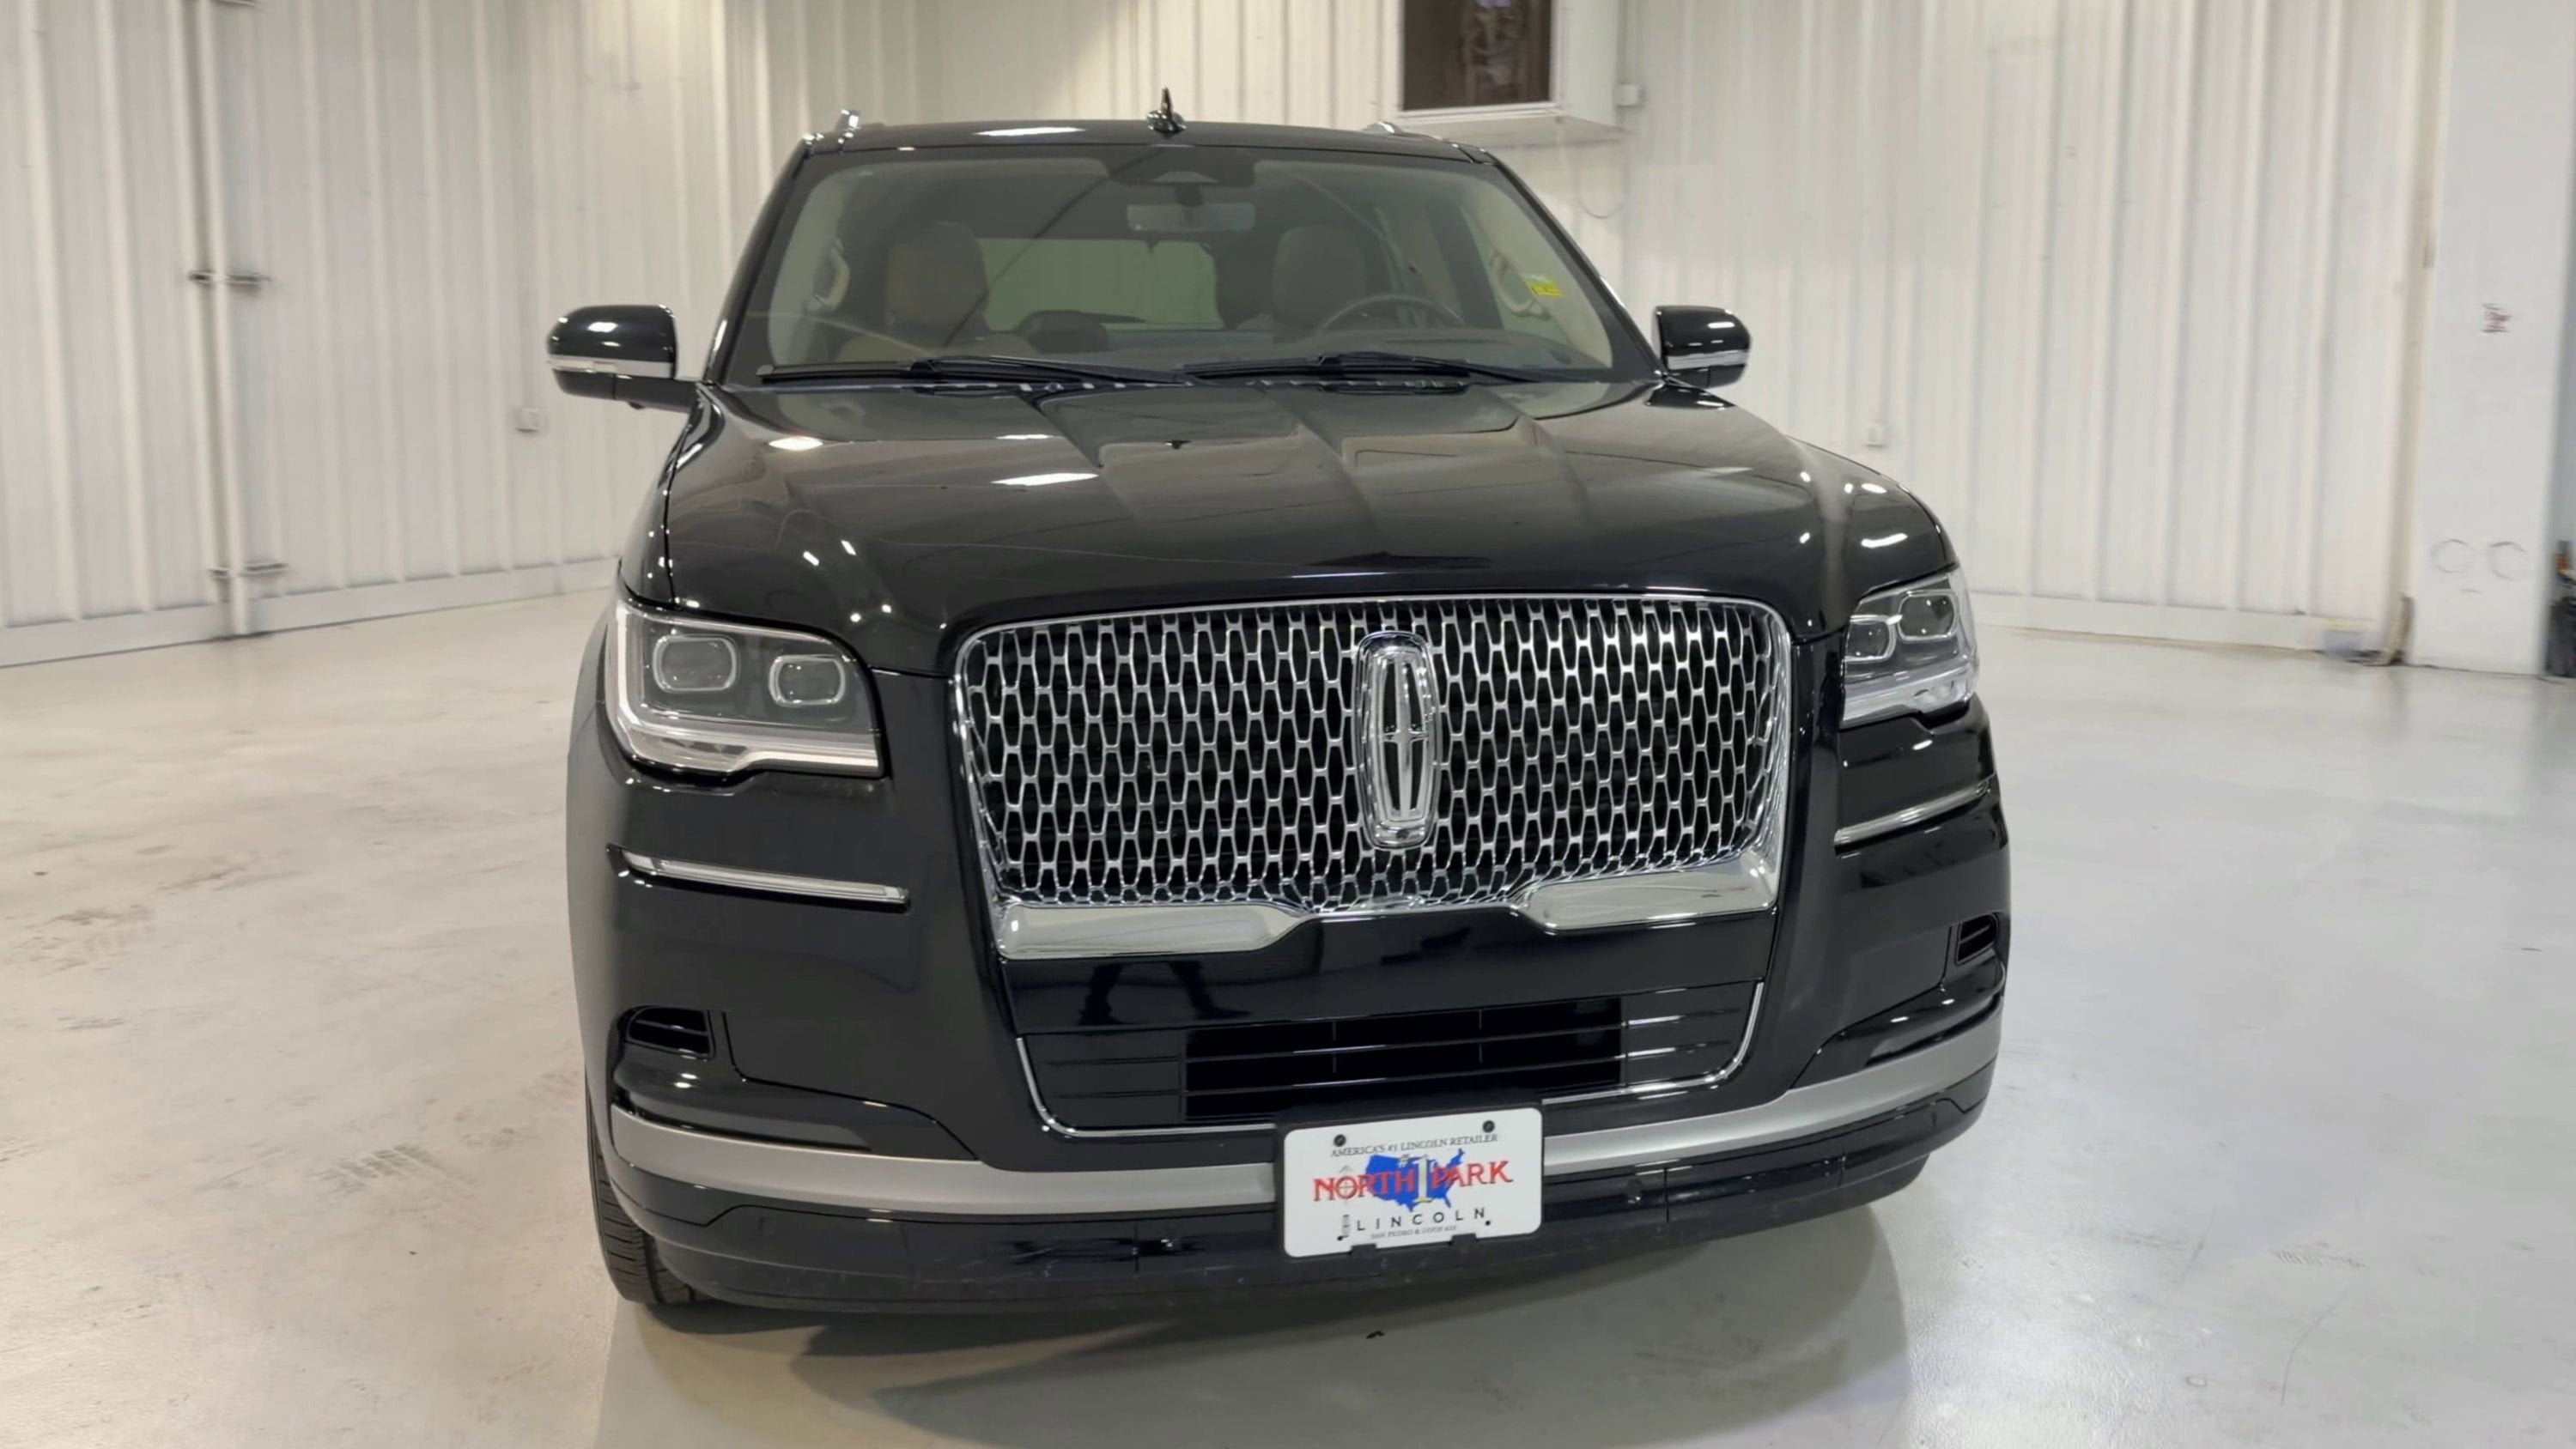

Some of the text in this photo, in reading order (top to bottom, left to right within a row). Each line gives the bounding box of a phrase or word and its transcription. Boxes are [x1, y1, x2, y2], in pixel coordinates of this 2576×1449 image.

[1400, 1137, 1448, 1151] LINCOLN
[1449, 1133, 1498, 1146] RETAILER
[1313, 1160, 1514, 1202] NORTH PARK
[1357, 1208, 1485, 1231] LINCOLN
